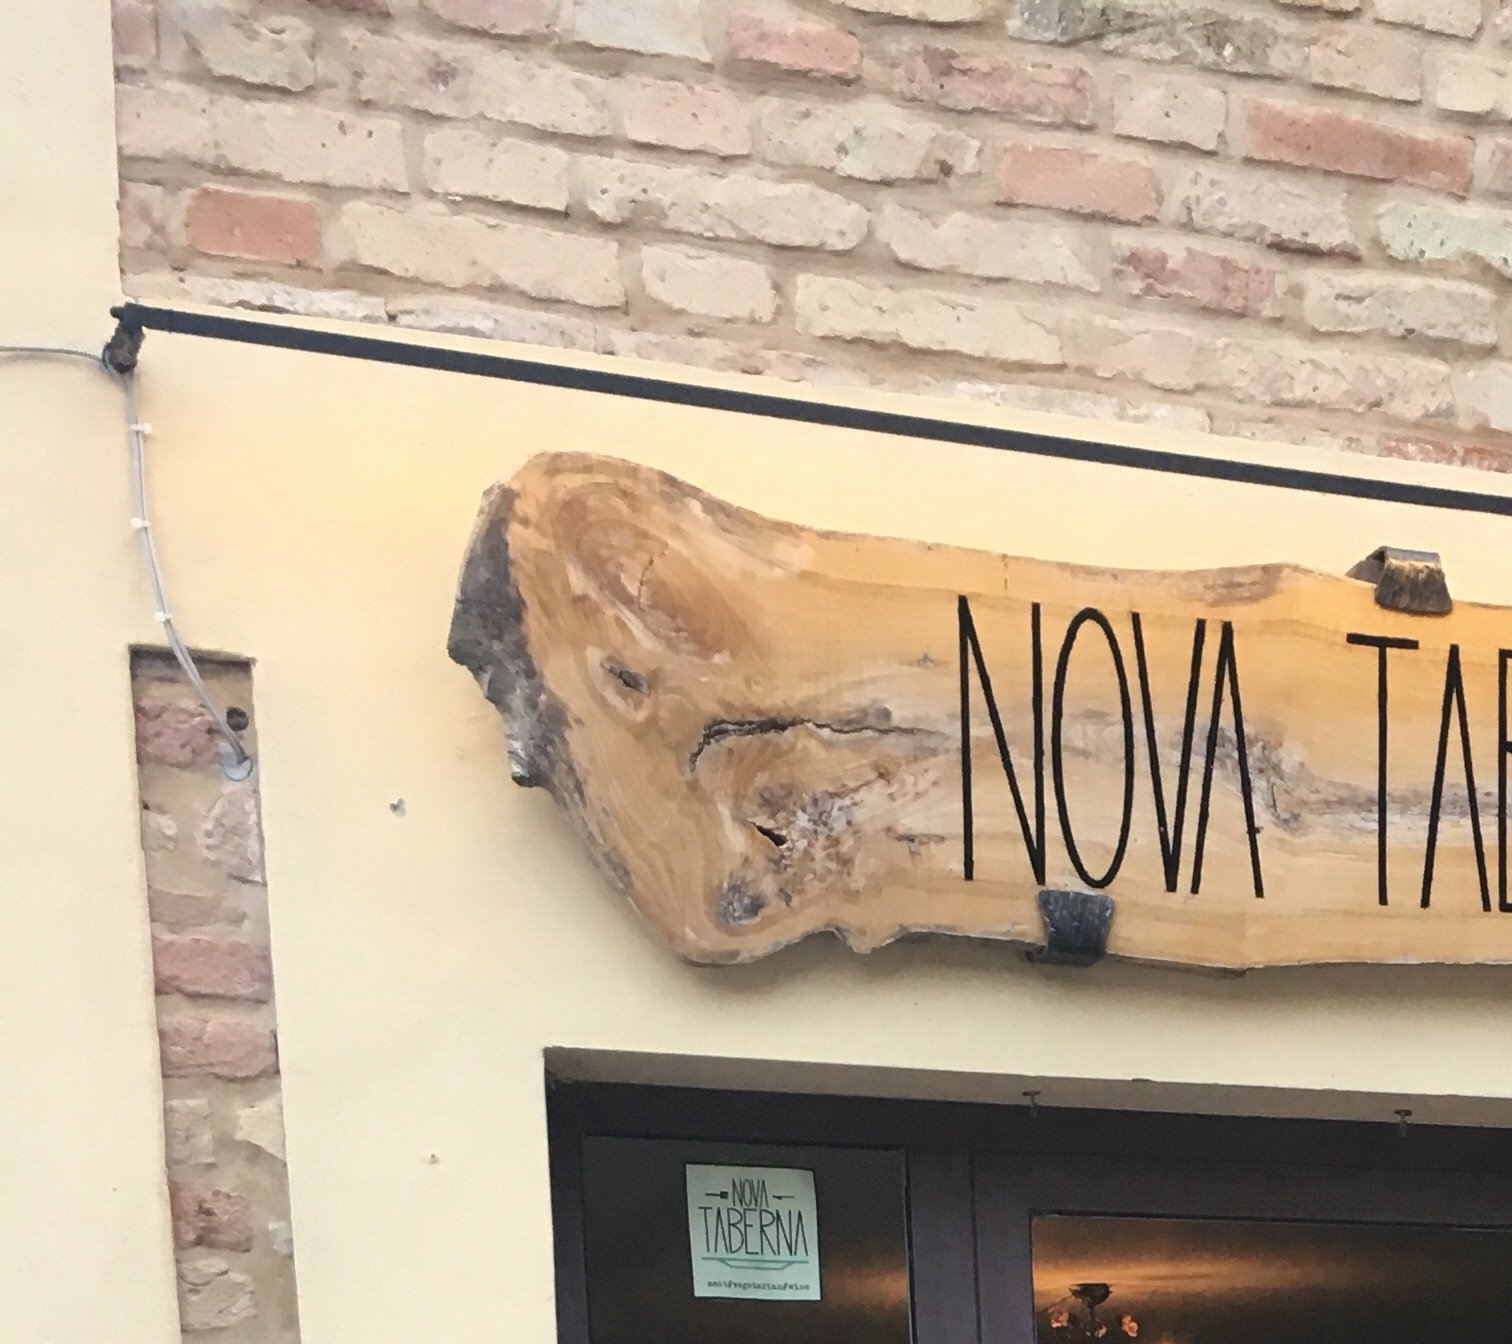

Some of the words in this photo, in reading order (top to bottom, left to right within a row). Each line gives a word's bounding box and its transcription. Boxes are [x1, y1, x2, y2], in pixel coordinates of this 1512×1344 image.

[956, 593, 1265, 900] NOVA
[732, 1178, 769, 1208] NOVA
[697, 1206, 809, 1256] TABERNA
